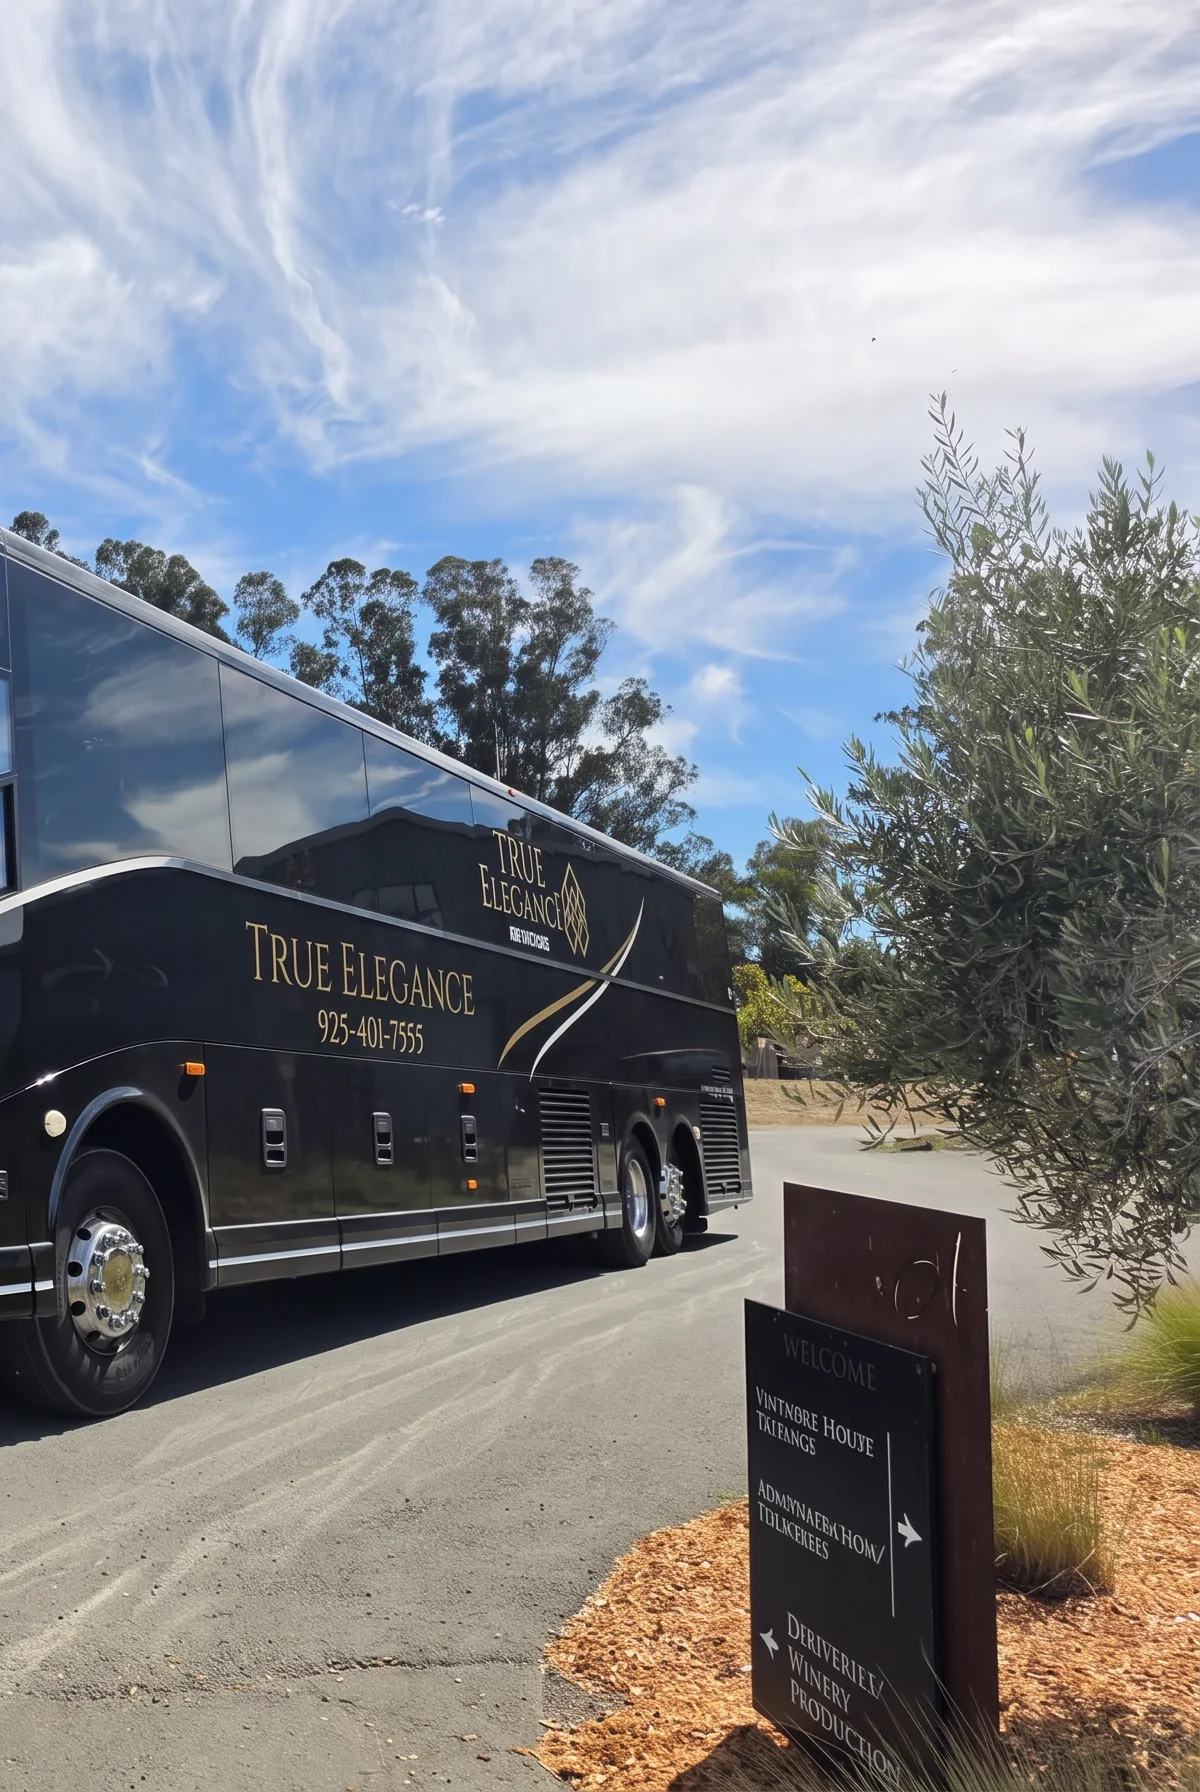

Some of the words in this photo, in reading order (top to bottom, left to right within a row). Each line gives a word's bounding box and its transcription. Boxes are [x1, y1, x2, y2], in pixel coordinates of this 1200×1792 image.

[492, 830, 546, 888] TRUE
[478, 863, 564, 931] ELEGANCE
[245, 920, 333, 992] TRUE
[340, 941, 476, 1016] ELEGANCE
[317, 1009, 424, 1055] 925-401-7555
[783, 1332, 877, 1391] WELCOME
[788, 1644, 851, 1713] WINERY
[790, 1676, 901, 1786] PRODUCTION
